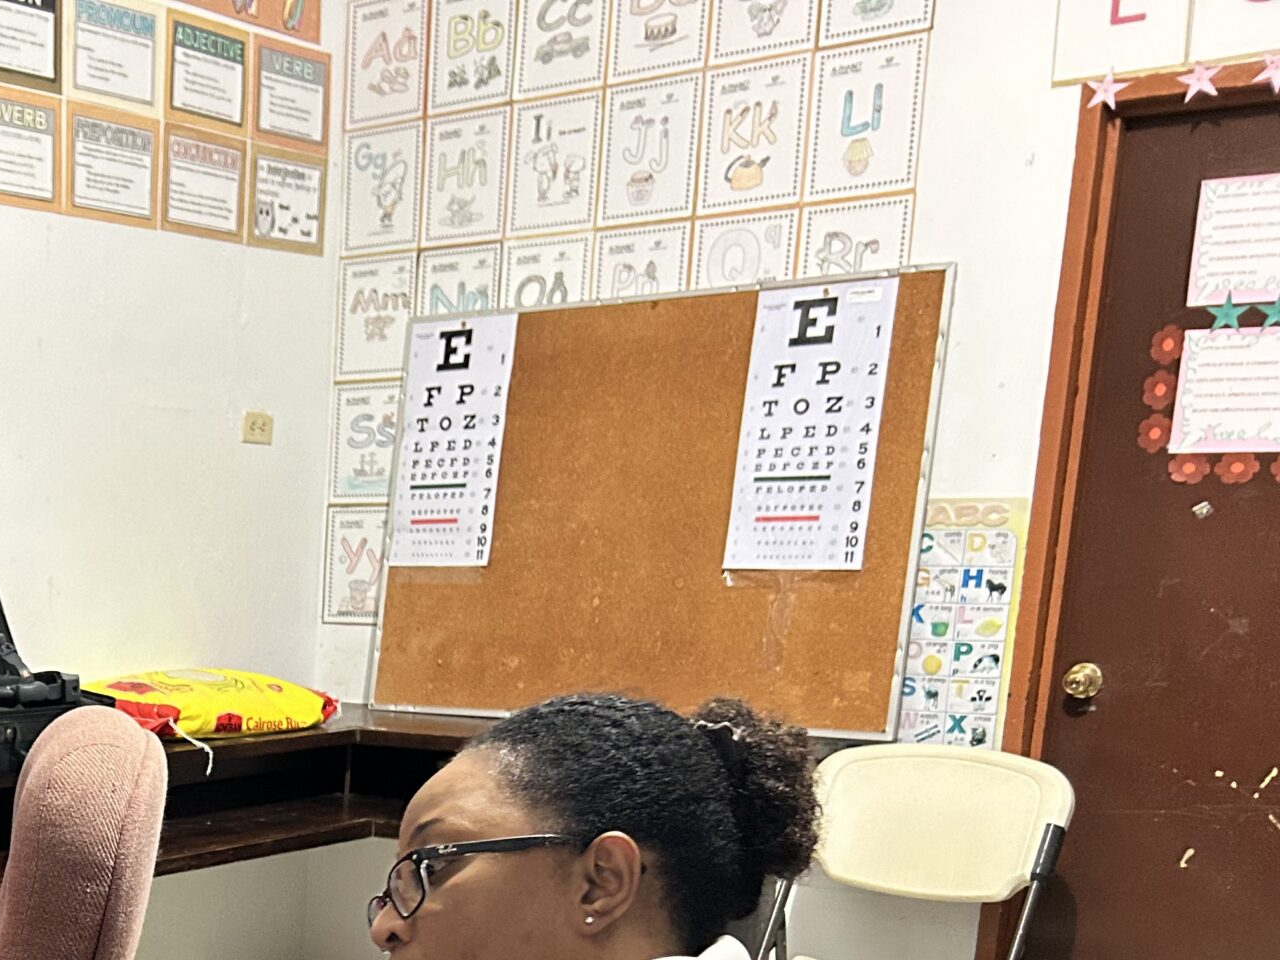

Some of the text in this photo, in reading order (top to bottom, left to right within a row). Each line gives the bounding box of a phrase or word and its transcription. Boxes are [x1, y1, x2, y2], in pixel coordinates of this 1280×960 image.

[76, 1, 155, 37] PRONOUN
[176, 25, 244, 61] ADJECTIVE
[447, 9, 505, 59] Bb
[361, 27, 418, 70] Aa
[271, 52, 314, 80] VERB
[622, 115, 669, 174] Jj
[354, 142, 387, 180] Gg
[437, 146, 487, 192] Hh
[349, 288, 410, 315] Mm
[788, 296, 839, 347] E
[436, 328, 473, 372] E
[868, 363, 878, 375] 2
[494, 386, 502, 397] 2
[865, 396, 875, 409] 3
[492, 415, 500, 425] 3
[860, 422, 871, 436] 4
[858, 442, 868, 455] 5
[486, 454, 494, 466] 5
[857, 458, 865, 470] 6
[485, 467, 492, 479] 6
[483, 488, 491, 499] 7
[854, 481, 865, 493] 7
[852, 501, 861, 512] 8
[925, 504, 1010, 527] ABC
[480, 523, 487, 534] 9
[850, 521, 859, 533] 9
[477, 535, 487, 547] 10
[845, 536, 859, 548] 10
[967, 532, 987, 553] D
[844, 551, 854, 563] 11
[961, 569, 984, 588] H
[957, 606, 974, 624] L
[953, 642, 973, 661] P
[903, 676, 916, 696] S
[951, 679, 970, 699] T
[246, 717, 283, 731] Calrose
[946, 715, 968, 734] X
